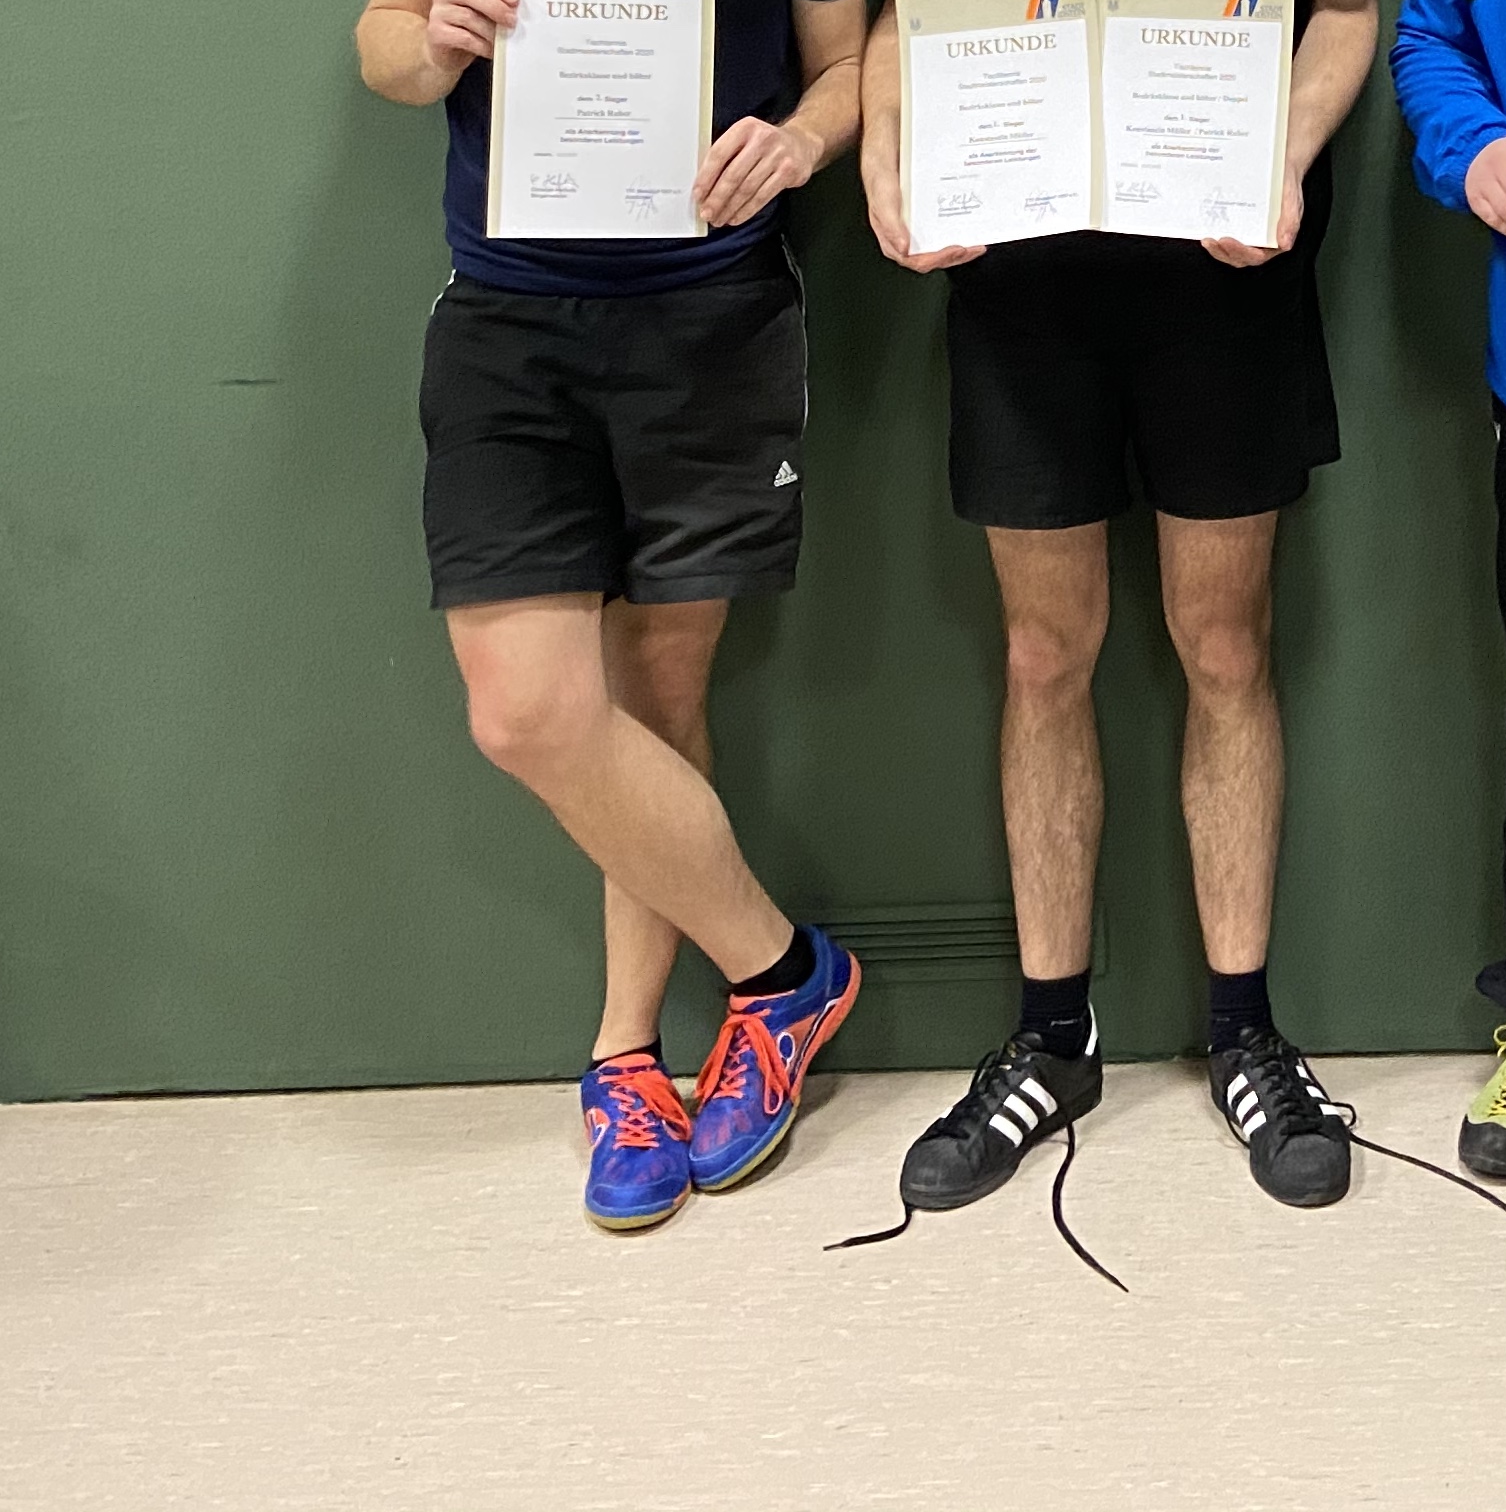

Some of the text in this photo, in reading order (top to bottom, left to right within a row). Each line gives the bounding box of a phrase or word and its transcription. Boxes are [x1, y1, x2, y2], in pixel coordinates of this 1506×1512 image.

[546, 1, 668, 21] URKUNDE
[946, 34, 1058, 58] URKUNDE
[1140, 28, 1251, 48] URKUNDE
